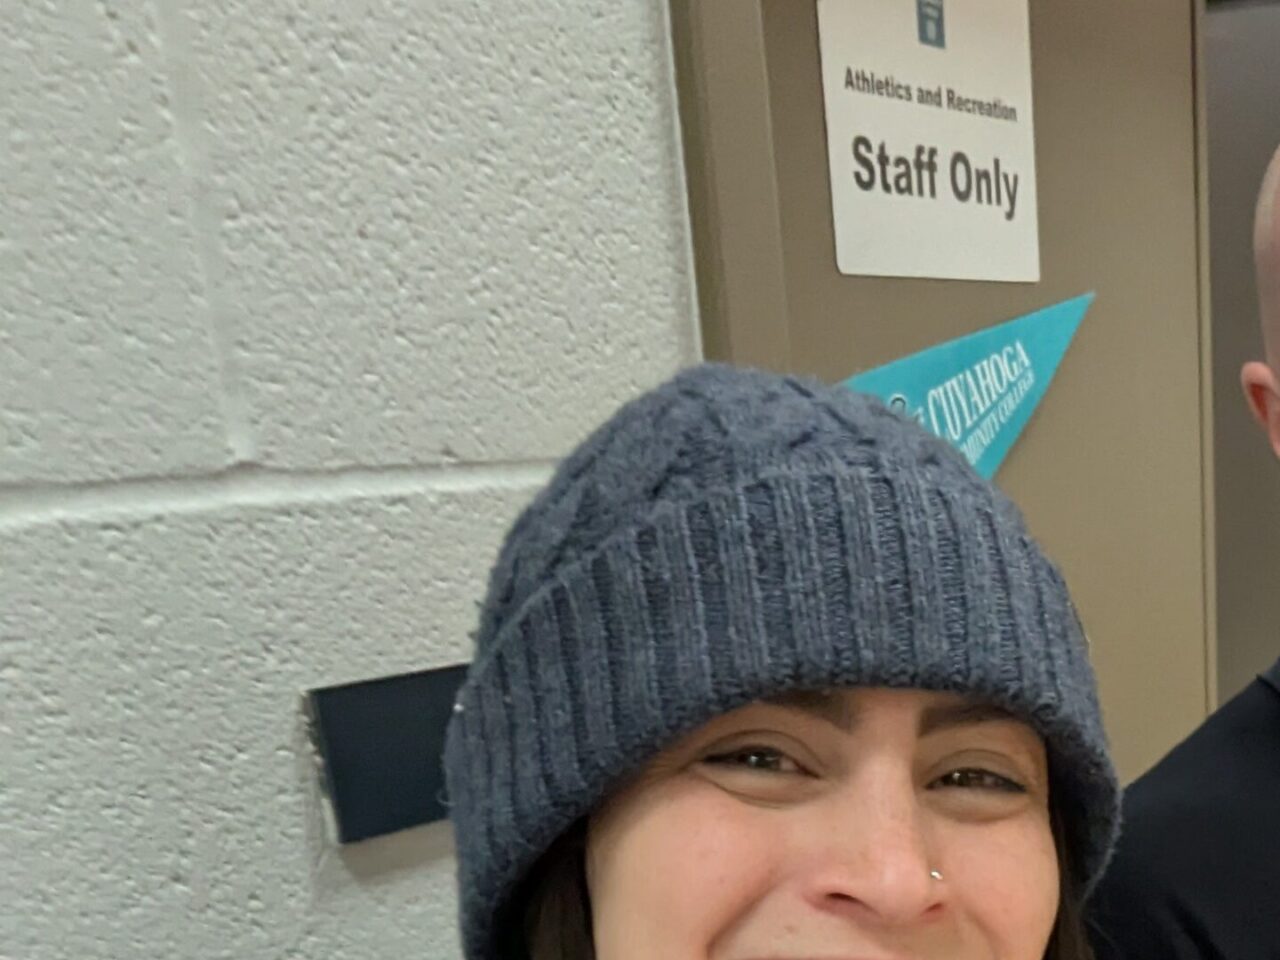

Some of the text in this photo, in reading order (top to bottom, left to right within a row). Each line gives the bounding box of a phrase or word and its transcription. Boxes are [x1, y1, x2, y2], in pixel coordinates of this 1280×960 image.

[844, 66, 1018, 122] Athletics and Recreation
[852, 135, 1018, 221] Staff Only
